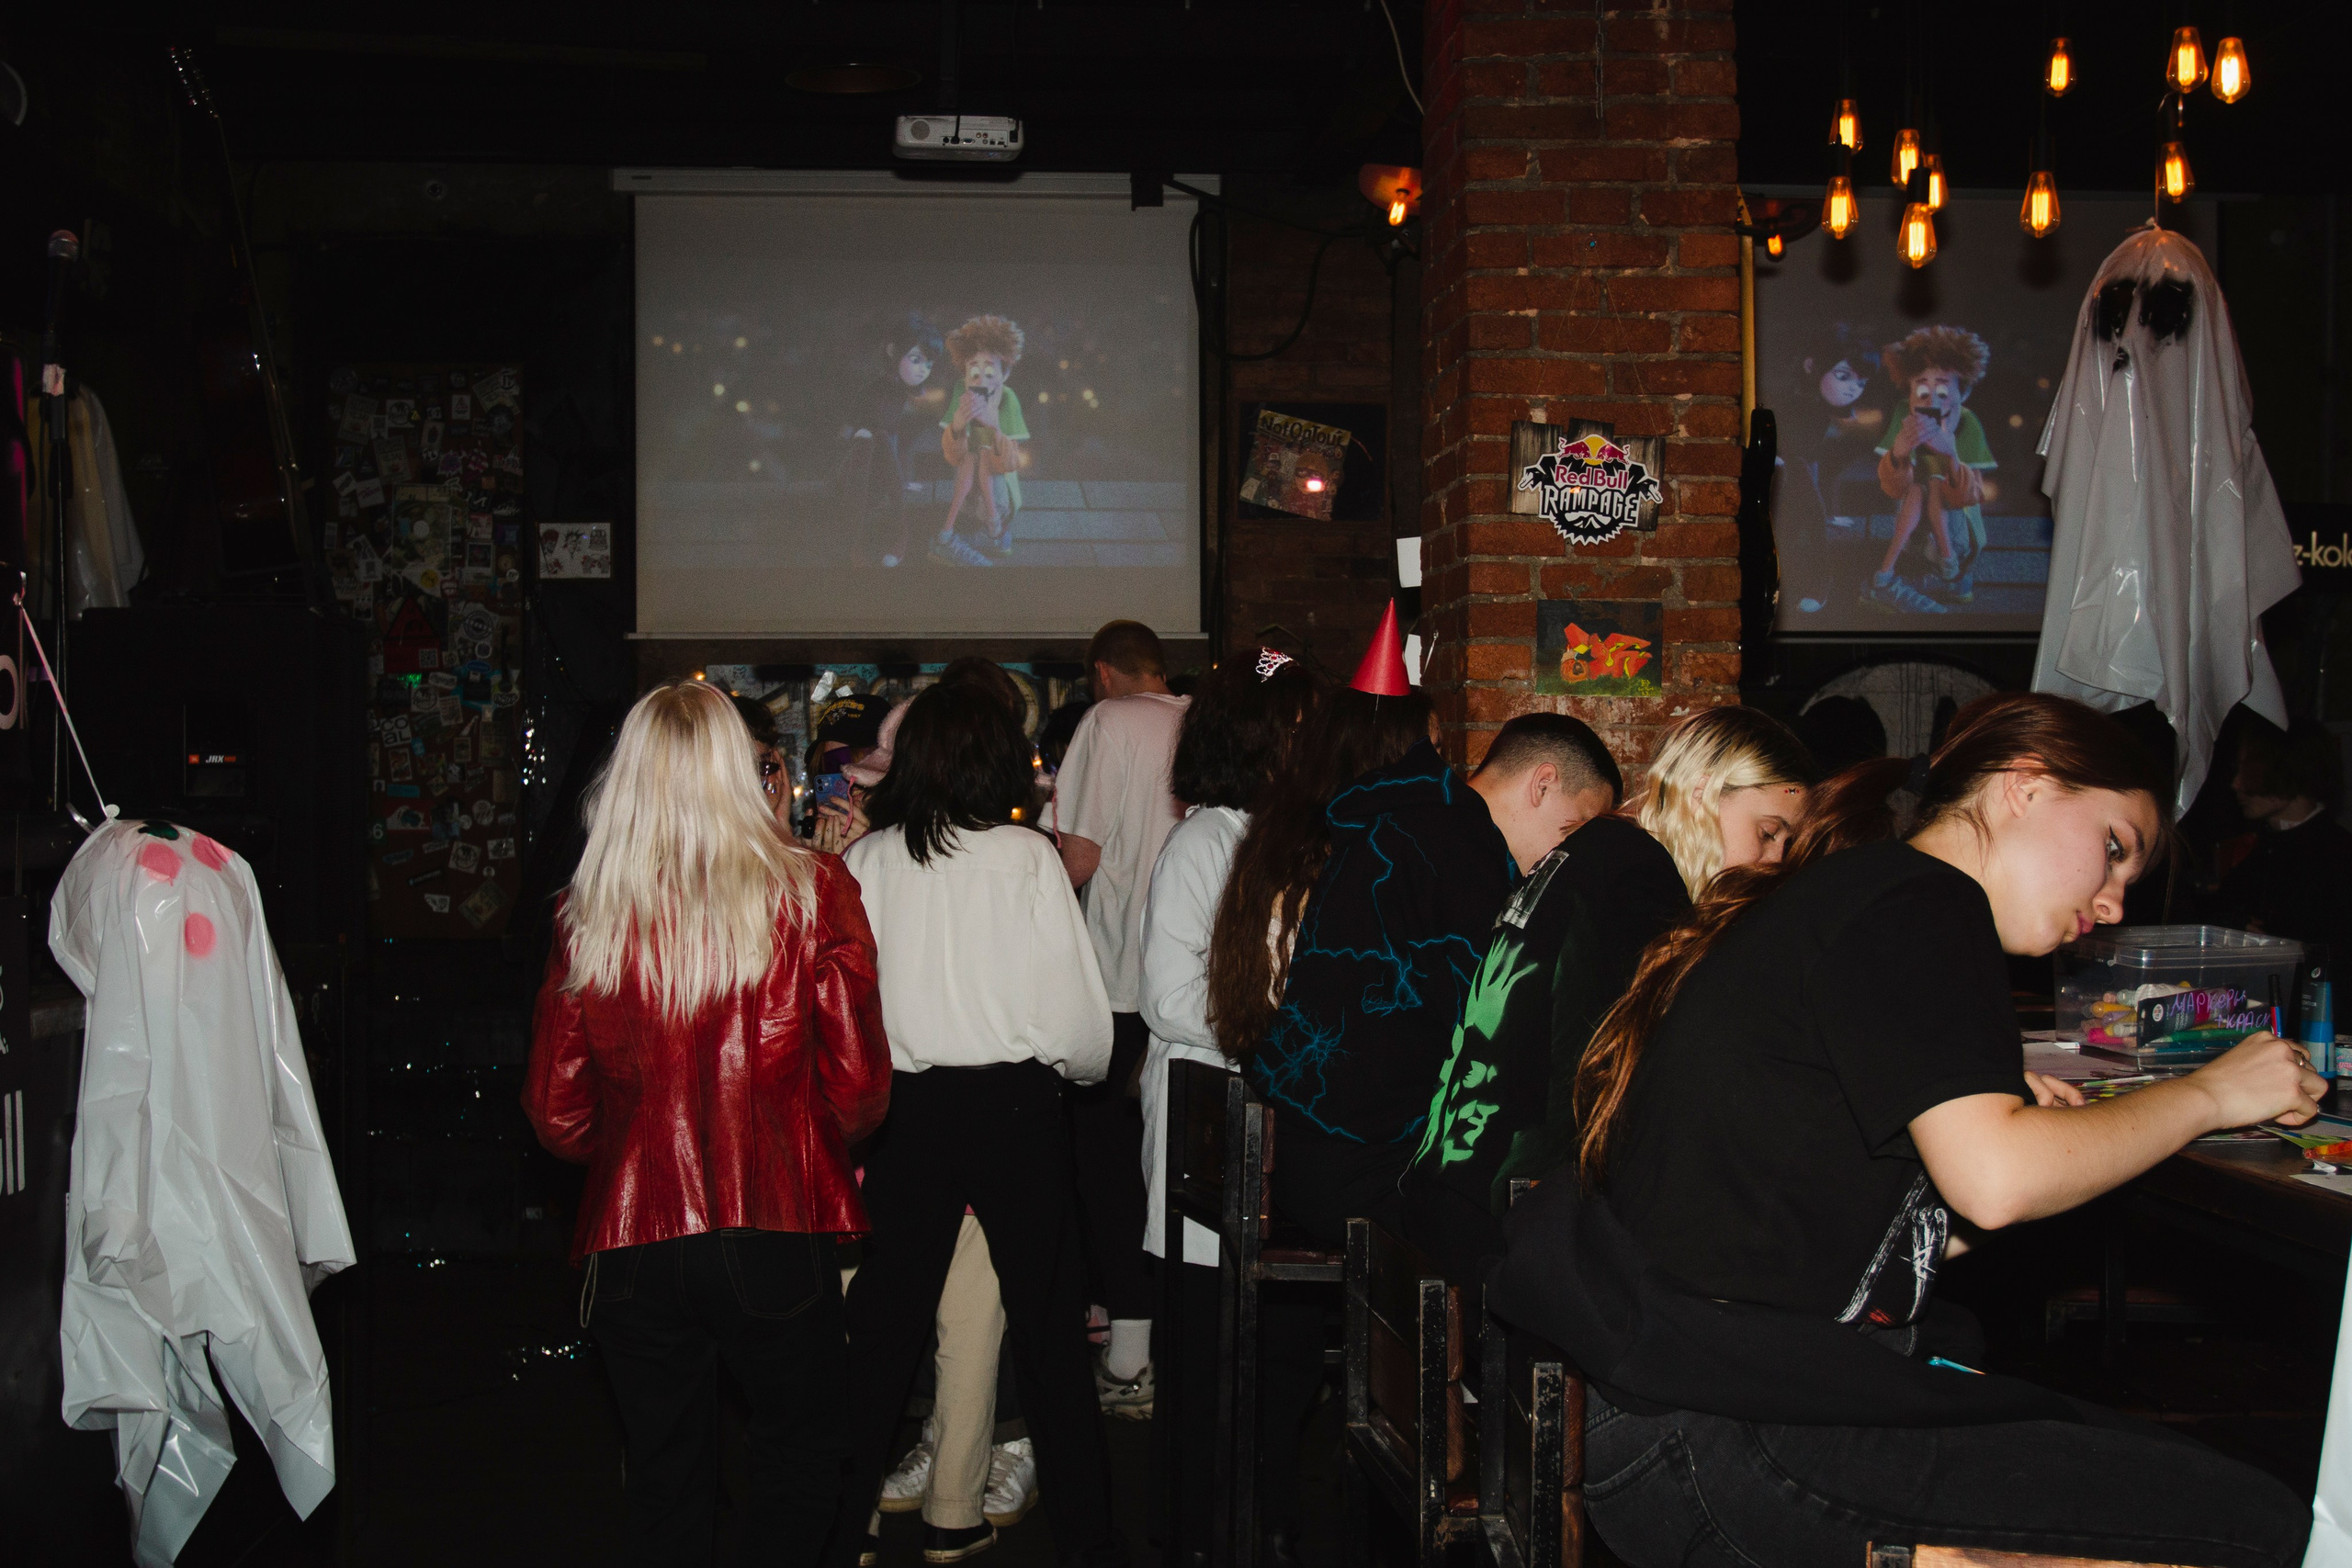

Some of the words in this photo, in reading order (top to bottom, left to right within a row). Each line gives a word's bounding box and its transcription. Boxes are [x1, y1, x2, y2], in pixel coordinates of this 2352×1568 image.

[1555, 466, 1591, 486] Red
[1593, 468, 1629, 490] Bull
[1544, 486, 1639, 524] RAMPAGE
[2293, 530, 2352, 569] z-kol
